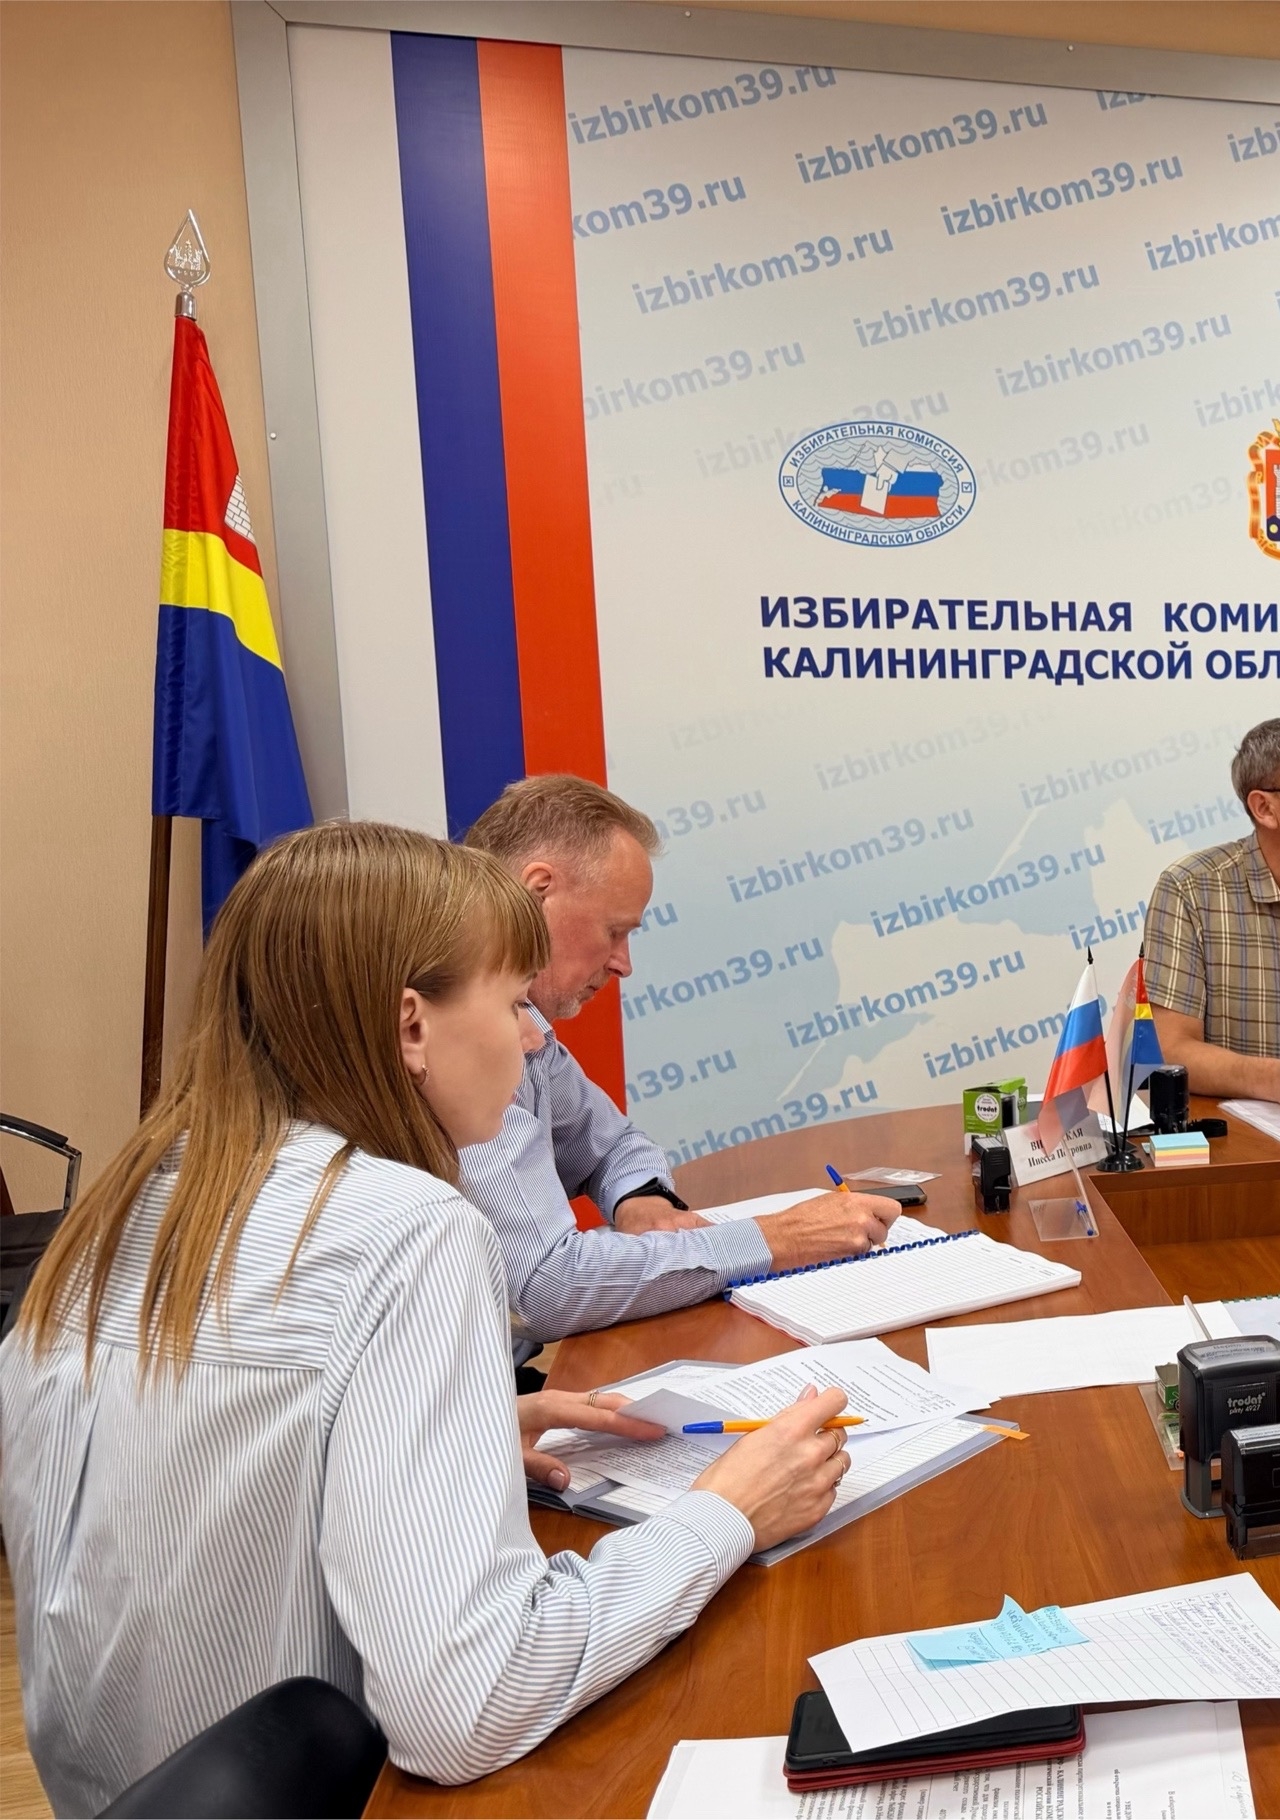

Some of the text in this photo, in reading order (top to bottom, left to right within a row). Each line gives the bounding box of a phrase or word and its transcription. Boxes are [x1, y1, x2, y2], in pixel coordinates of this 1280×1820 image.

[568, 65, 838, 145] izbirkom39.ru
[794, 101, 1048, 184] izbirkom39.ru
[940, 155, 1184, 236] izbirkom39.ru
[632, 228, 894, 314] izbirkom39.ru
[853, 264, 1100, 348] izbirkom39.ru
[995, 313, 1232, 398] izbirkom39.ru
[788, 424, 965, 474] ИЗБИРАТЕЛЬНАЯ КОМИССИЯ
[791, 498, 967, 546] КАЛИНИНГРАДСКОЙ ОБЛАСТИ
[760, 596, 1132, 632] ИЗБИРАТЕЛЬНАЯ
[763, 641, 1192, 686] КАЛИНИНГРАДСКОЙ
[727, 807, 975, 902] izbirkom39.ru
[870, 841, 1105, 937] izbirkom39.ru
[785, 949, 1026, 1049] izbirkom39.ru
[977, 1105, 998, 1113] trodat
[1057, 1142, 1092, 1159] Перовна
[1227, 1394, 1263, 1408] trodat
